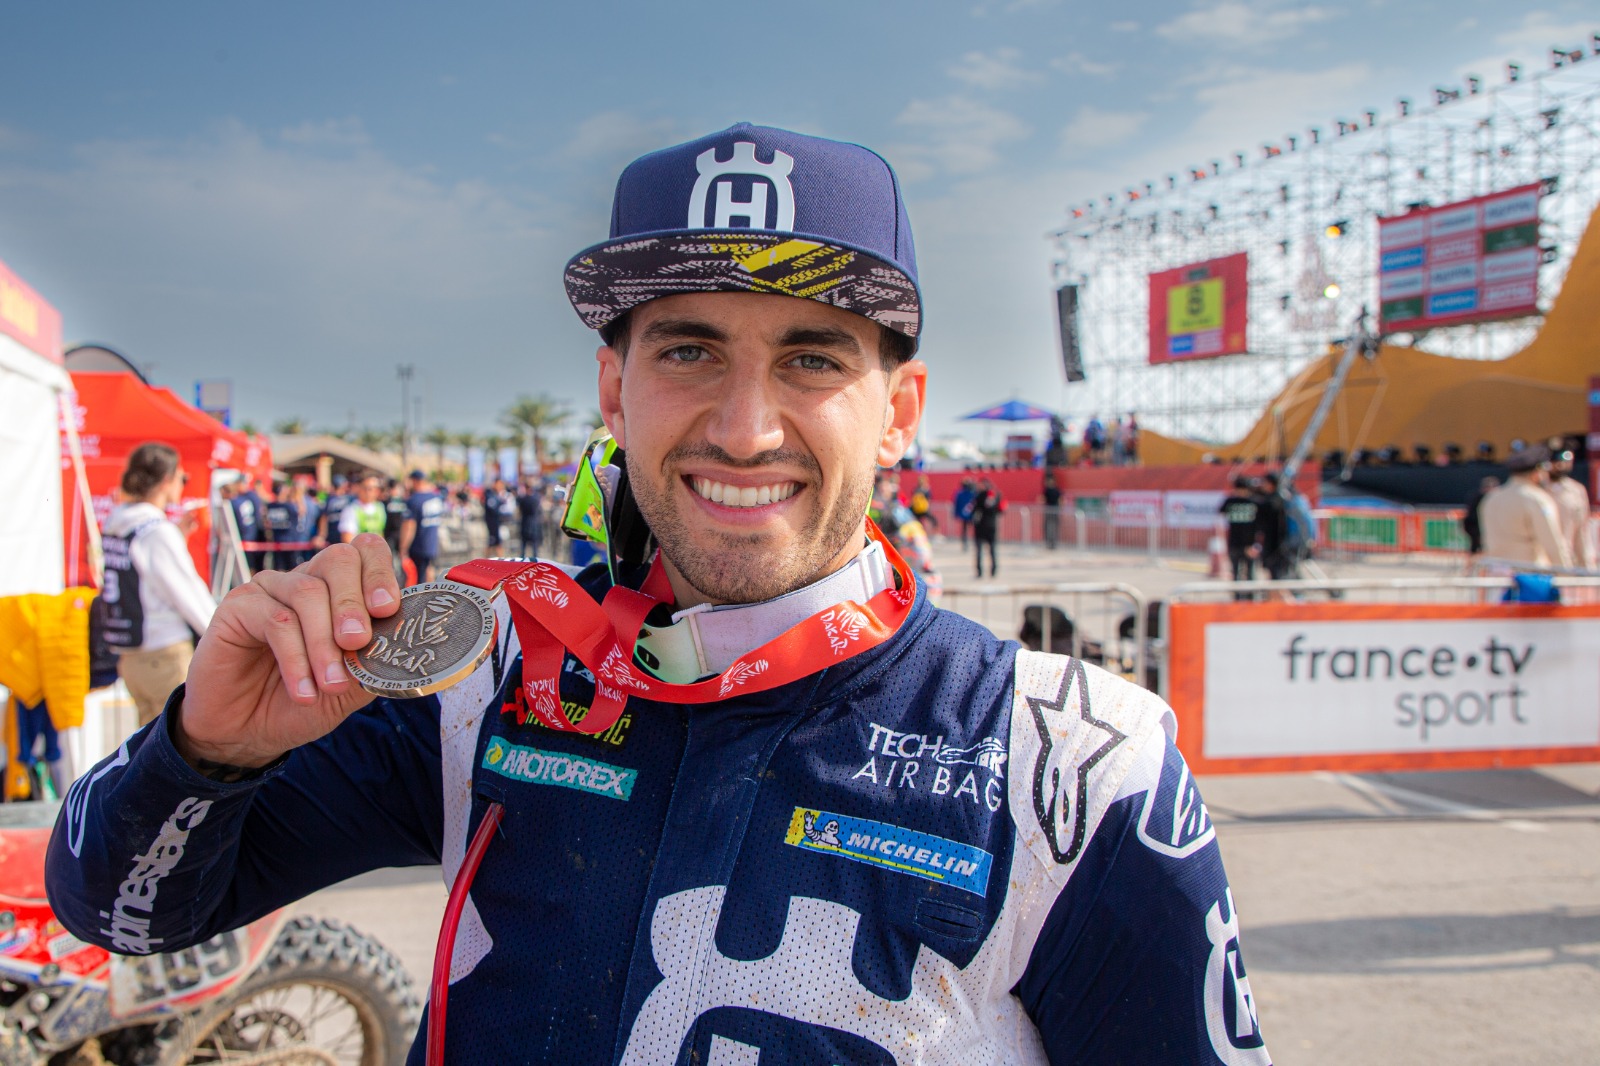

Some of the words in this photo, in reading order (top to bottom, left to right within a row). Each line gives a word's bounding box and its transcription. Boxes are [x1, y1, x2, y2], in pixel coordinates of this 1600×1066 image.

[424, 584, 459, 592] SAUDI
[461, 588, 491, 613] ARABIA
[482, 615, 493, 635] 2023
[820, 610, 848, 655] DAKAR
[346, 657, 378, 687] JANUARY
[381, 681, 403, 689] 15th
[407, 678, 433, 688] 2023
[364, 635, 435, 676] DAKAR
[597, 643, 623, 679] DAKAR
[526, 677, 556, 699] DAKAR
[1394, 684, 1528, 743] sport
[869, 722, 943, 758] TECH
[501, 749, 629, 796] MOTOREX
[852, 756, 919, 789] AIR
[931, 766, 1002, 812] BAG
[846, 832, 978, 877] MICHELIN
